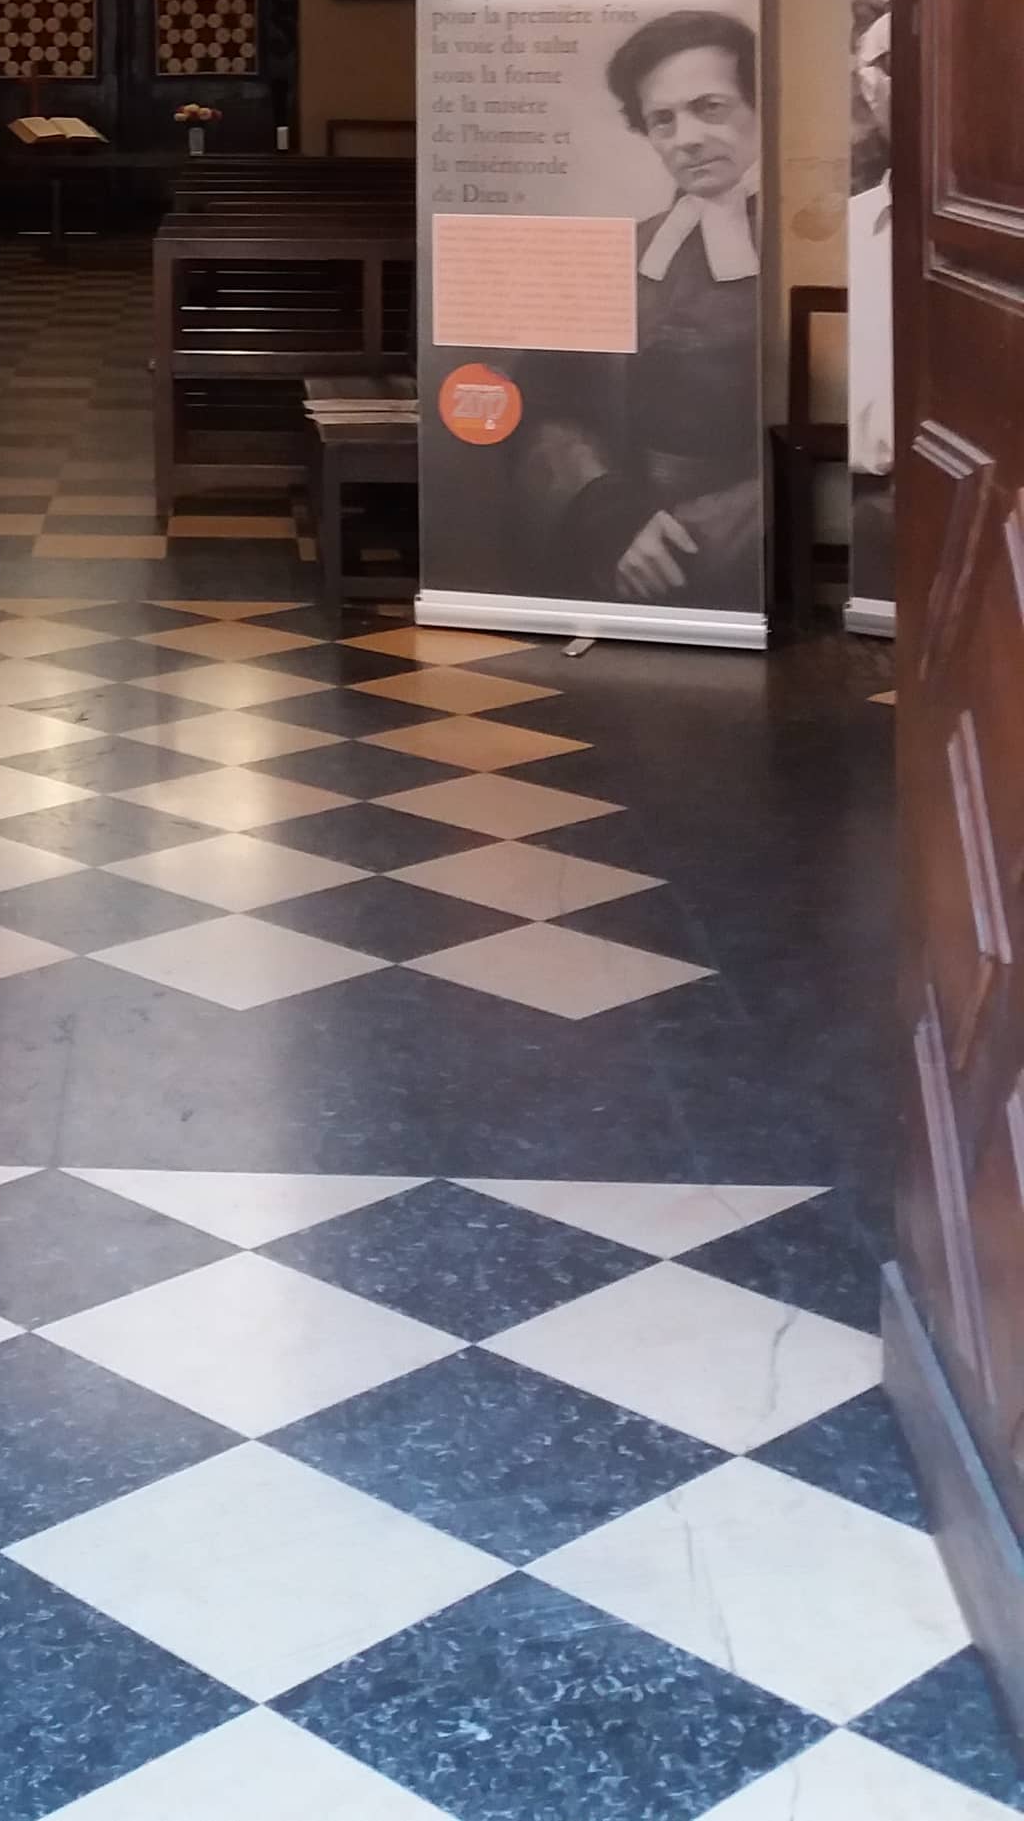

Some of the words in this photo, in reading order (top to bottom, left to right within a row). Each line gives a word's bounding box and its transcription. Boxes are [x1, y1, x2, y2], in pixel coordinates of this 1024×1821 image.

[432, 11, 477, 29] pour
[484, 5, 500, 24] la
[507, 6, 593, 30] première
[601, 4, 639, 23] fois
[432, 35, 448, 54] la
[455, 36, 494, 54] voie
[501, 35, 526, 54] du
[432, 70, 474, 84] sous
[481, 64, 497, 84] la
[505, 64, 562, 84] forme
[432, 95, 455, 114] de
[461, 94, 477, 114] la
[432, 123, 455, 143] de
[461, 123, 545, 144] l'homme
[552, 129, 571, 144] et
[456, 154, 568, 175] miséricorde
[432, 184, 456, 203] de
[463, 183, 509, 203] Dieu
